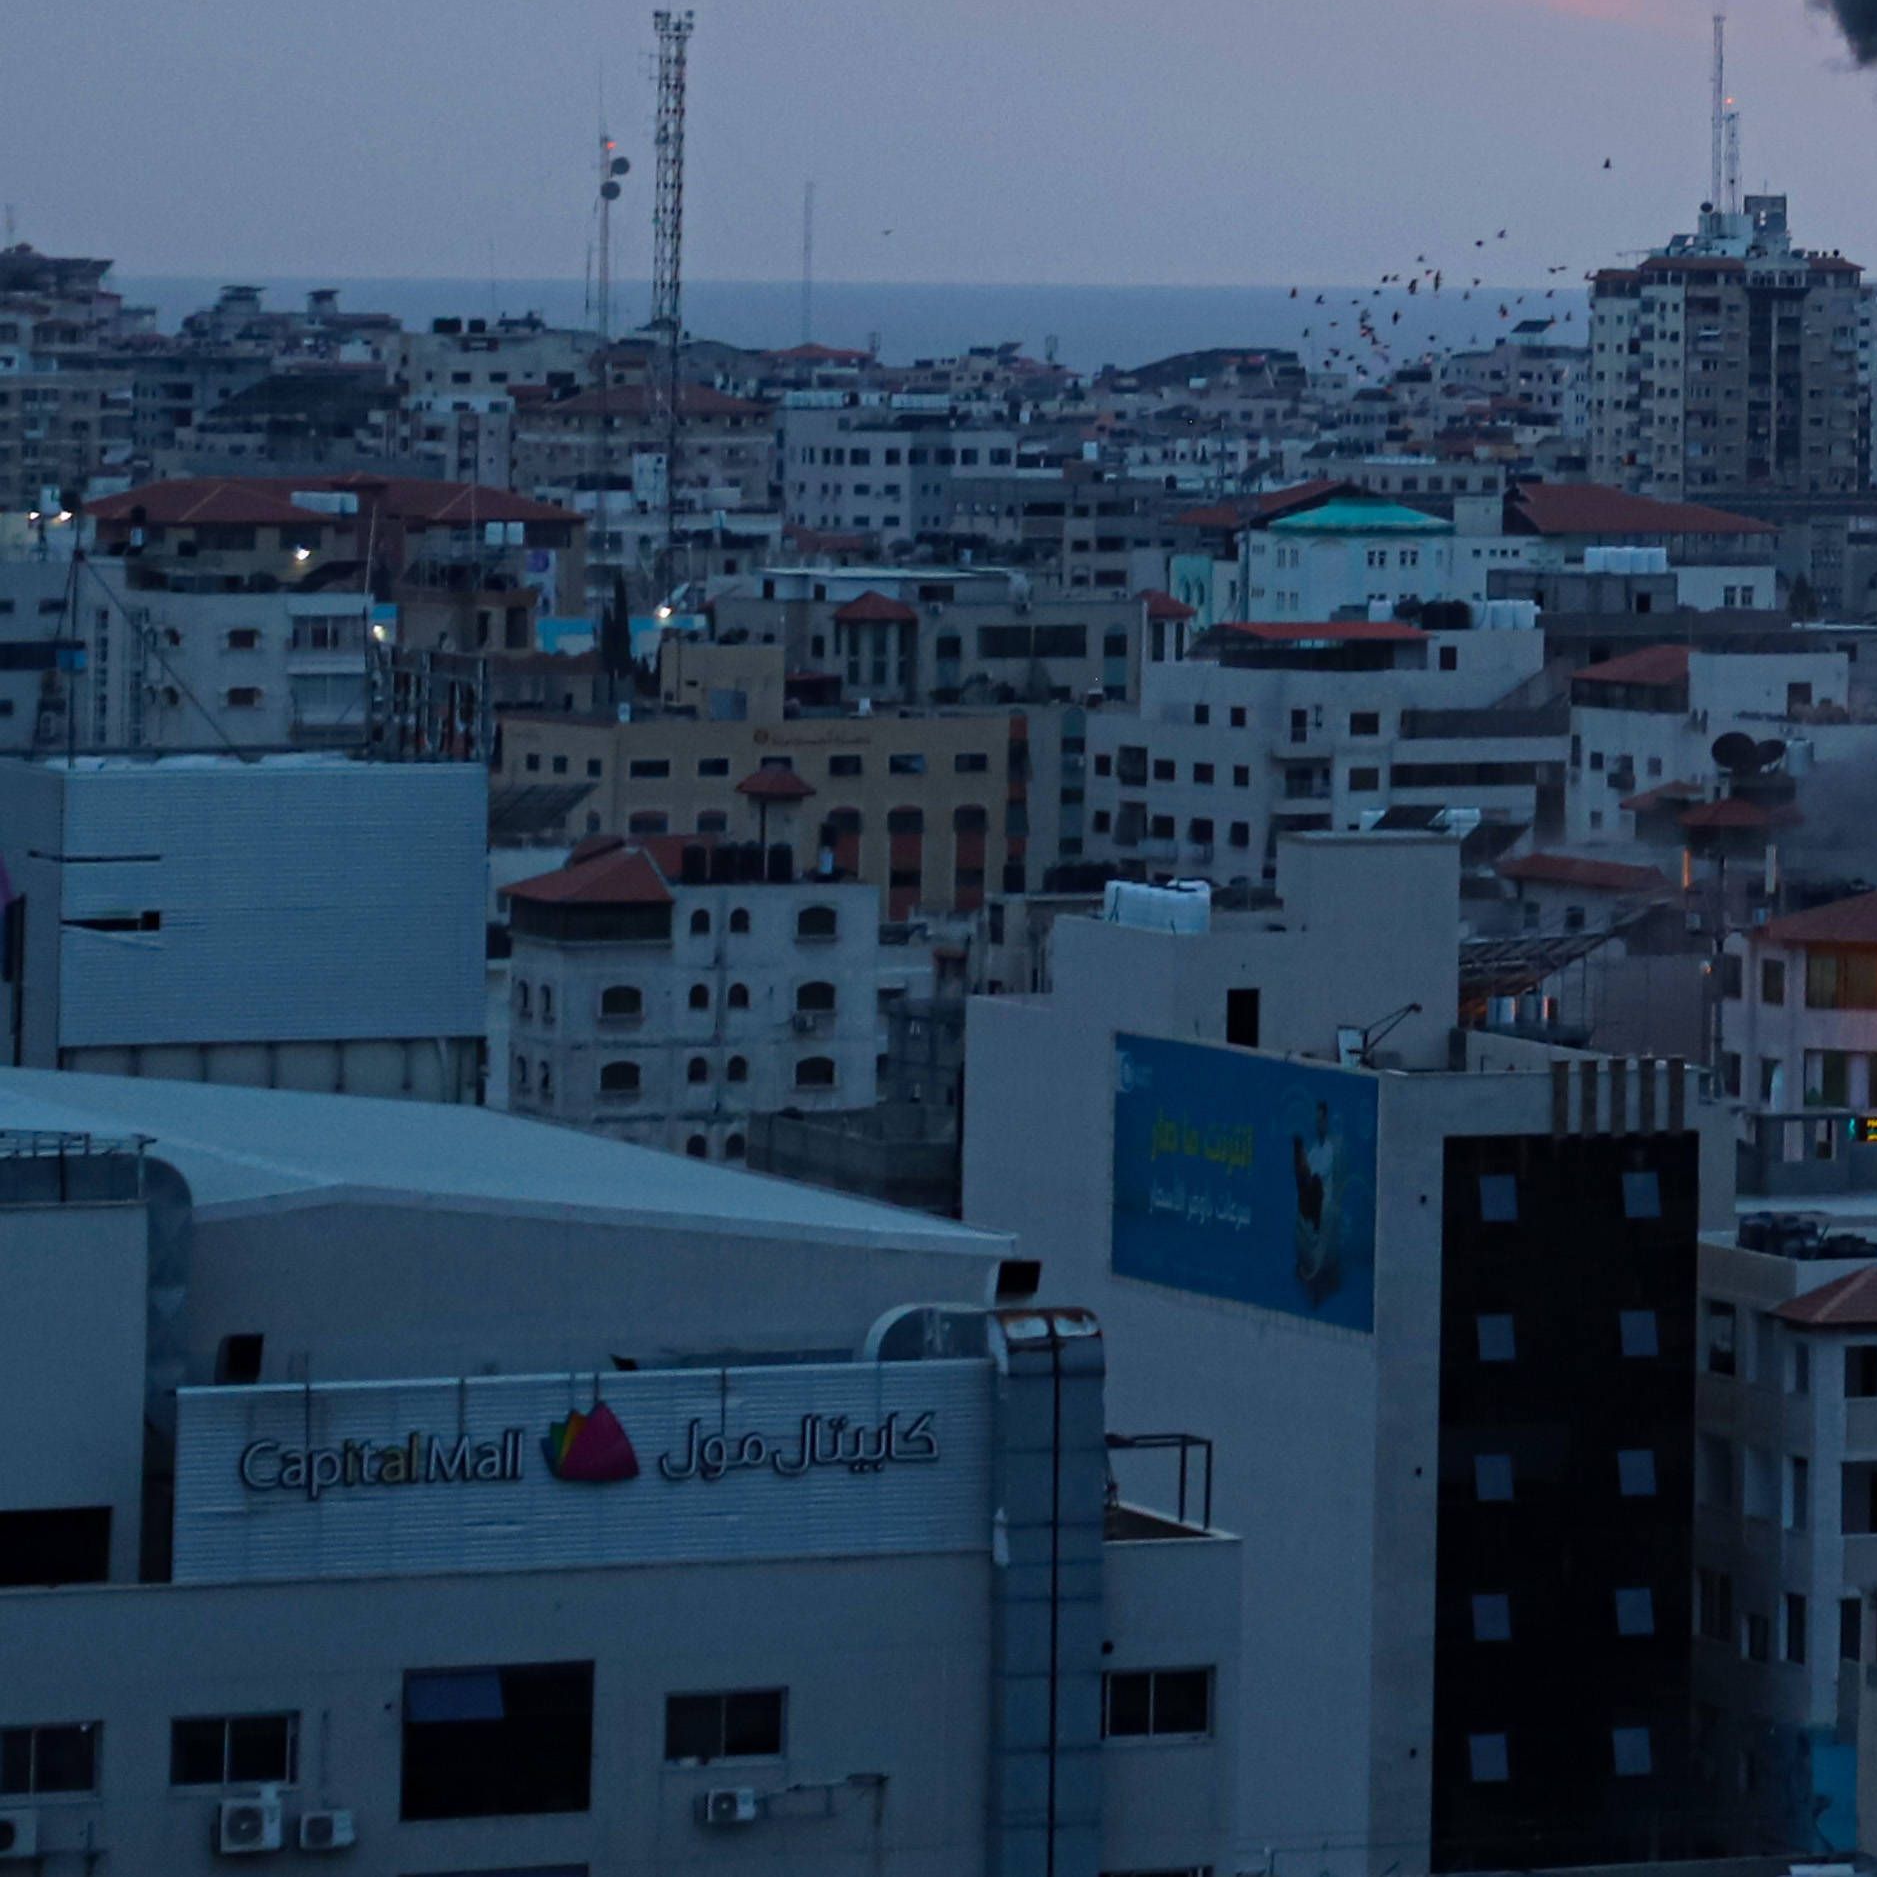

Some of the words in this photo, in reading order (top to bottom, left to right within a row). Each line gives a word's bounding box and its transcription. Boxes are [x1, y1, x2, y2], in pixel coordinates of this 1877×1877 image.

[240, 1431, 422, 1501] Capital
[425, 1427, 525, 1483] Mall
[658, 1417, 768, 1481] مول
[770, 1410, 941, 1475] كابيتال
